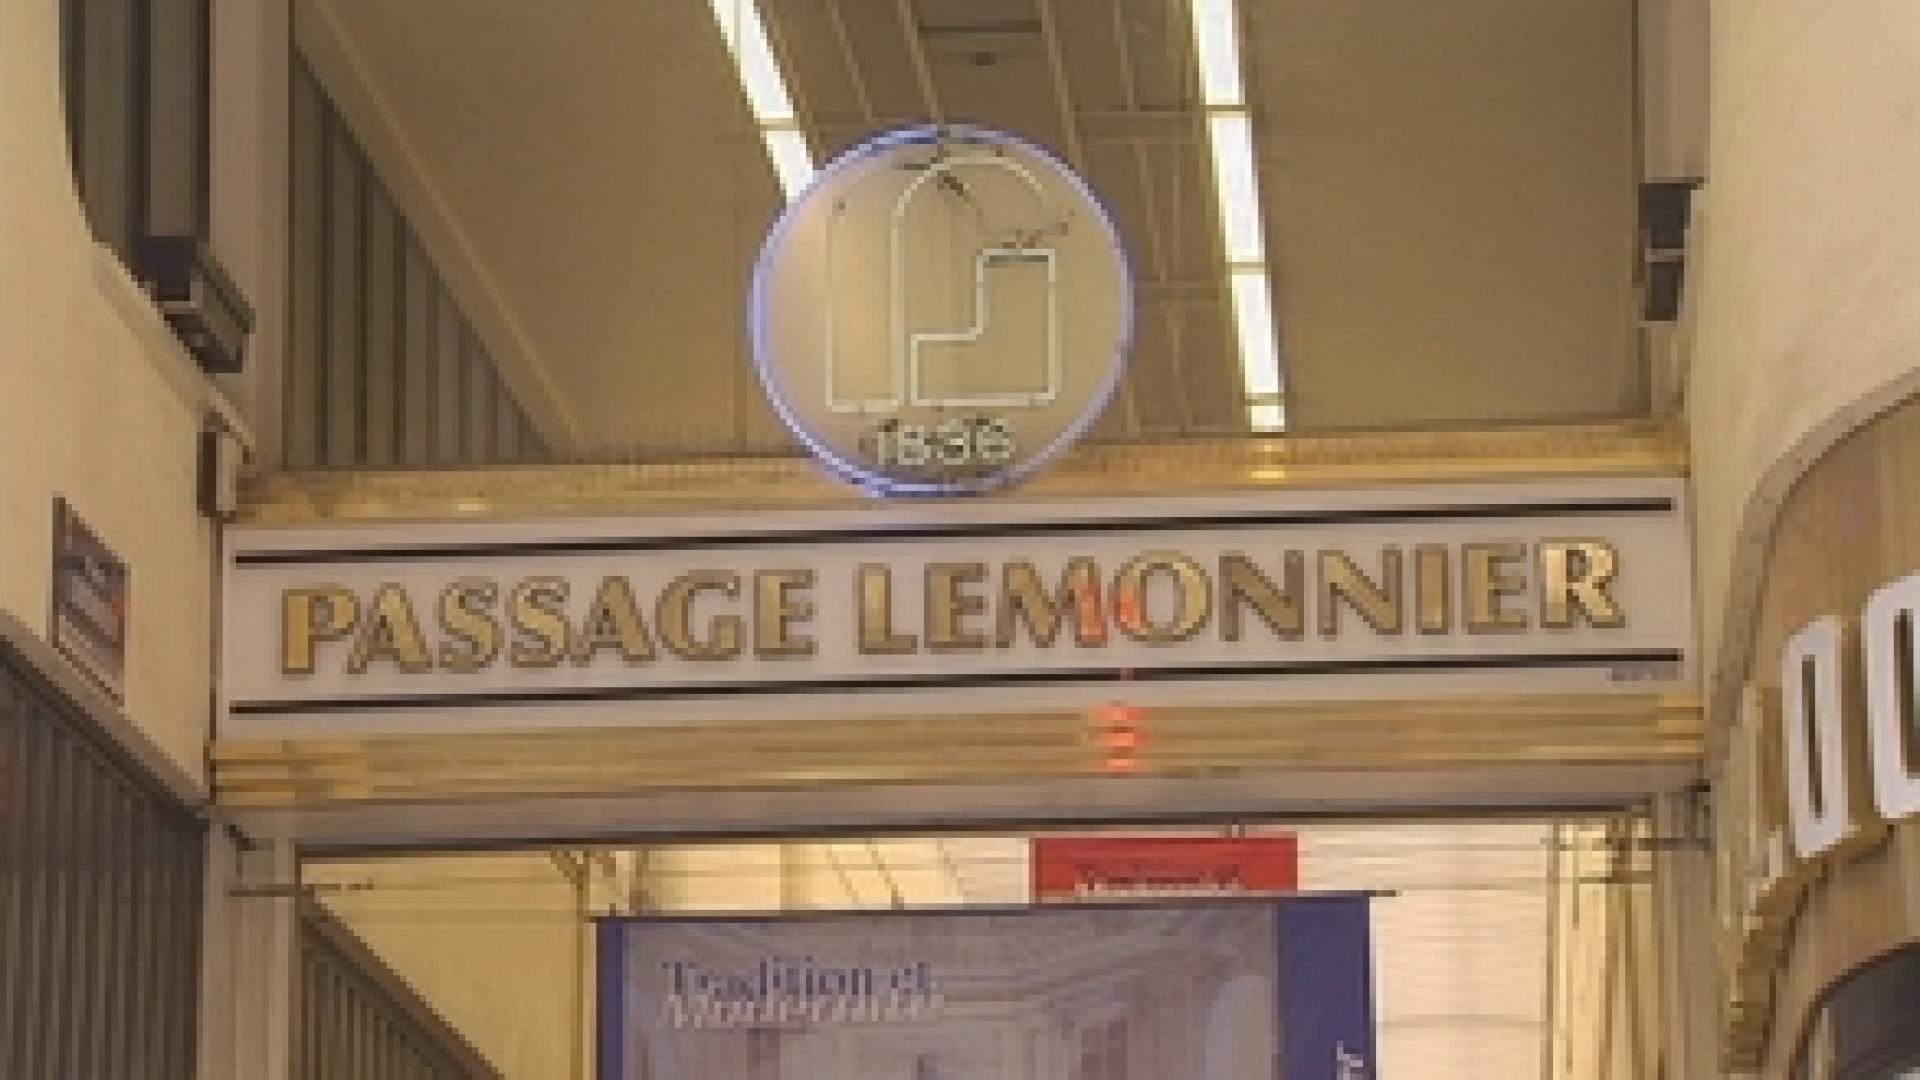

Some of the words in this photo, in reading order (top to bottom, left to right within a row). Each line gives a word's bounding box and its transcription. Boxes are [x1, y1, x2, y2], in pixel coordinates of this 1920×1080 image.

[280, 577, 815, 676] PASSAGE
[855, 537, 1626, 655] LEMONNIER
[661, 955, 873, 1001] Tradition
